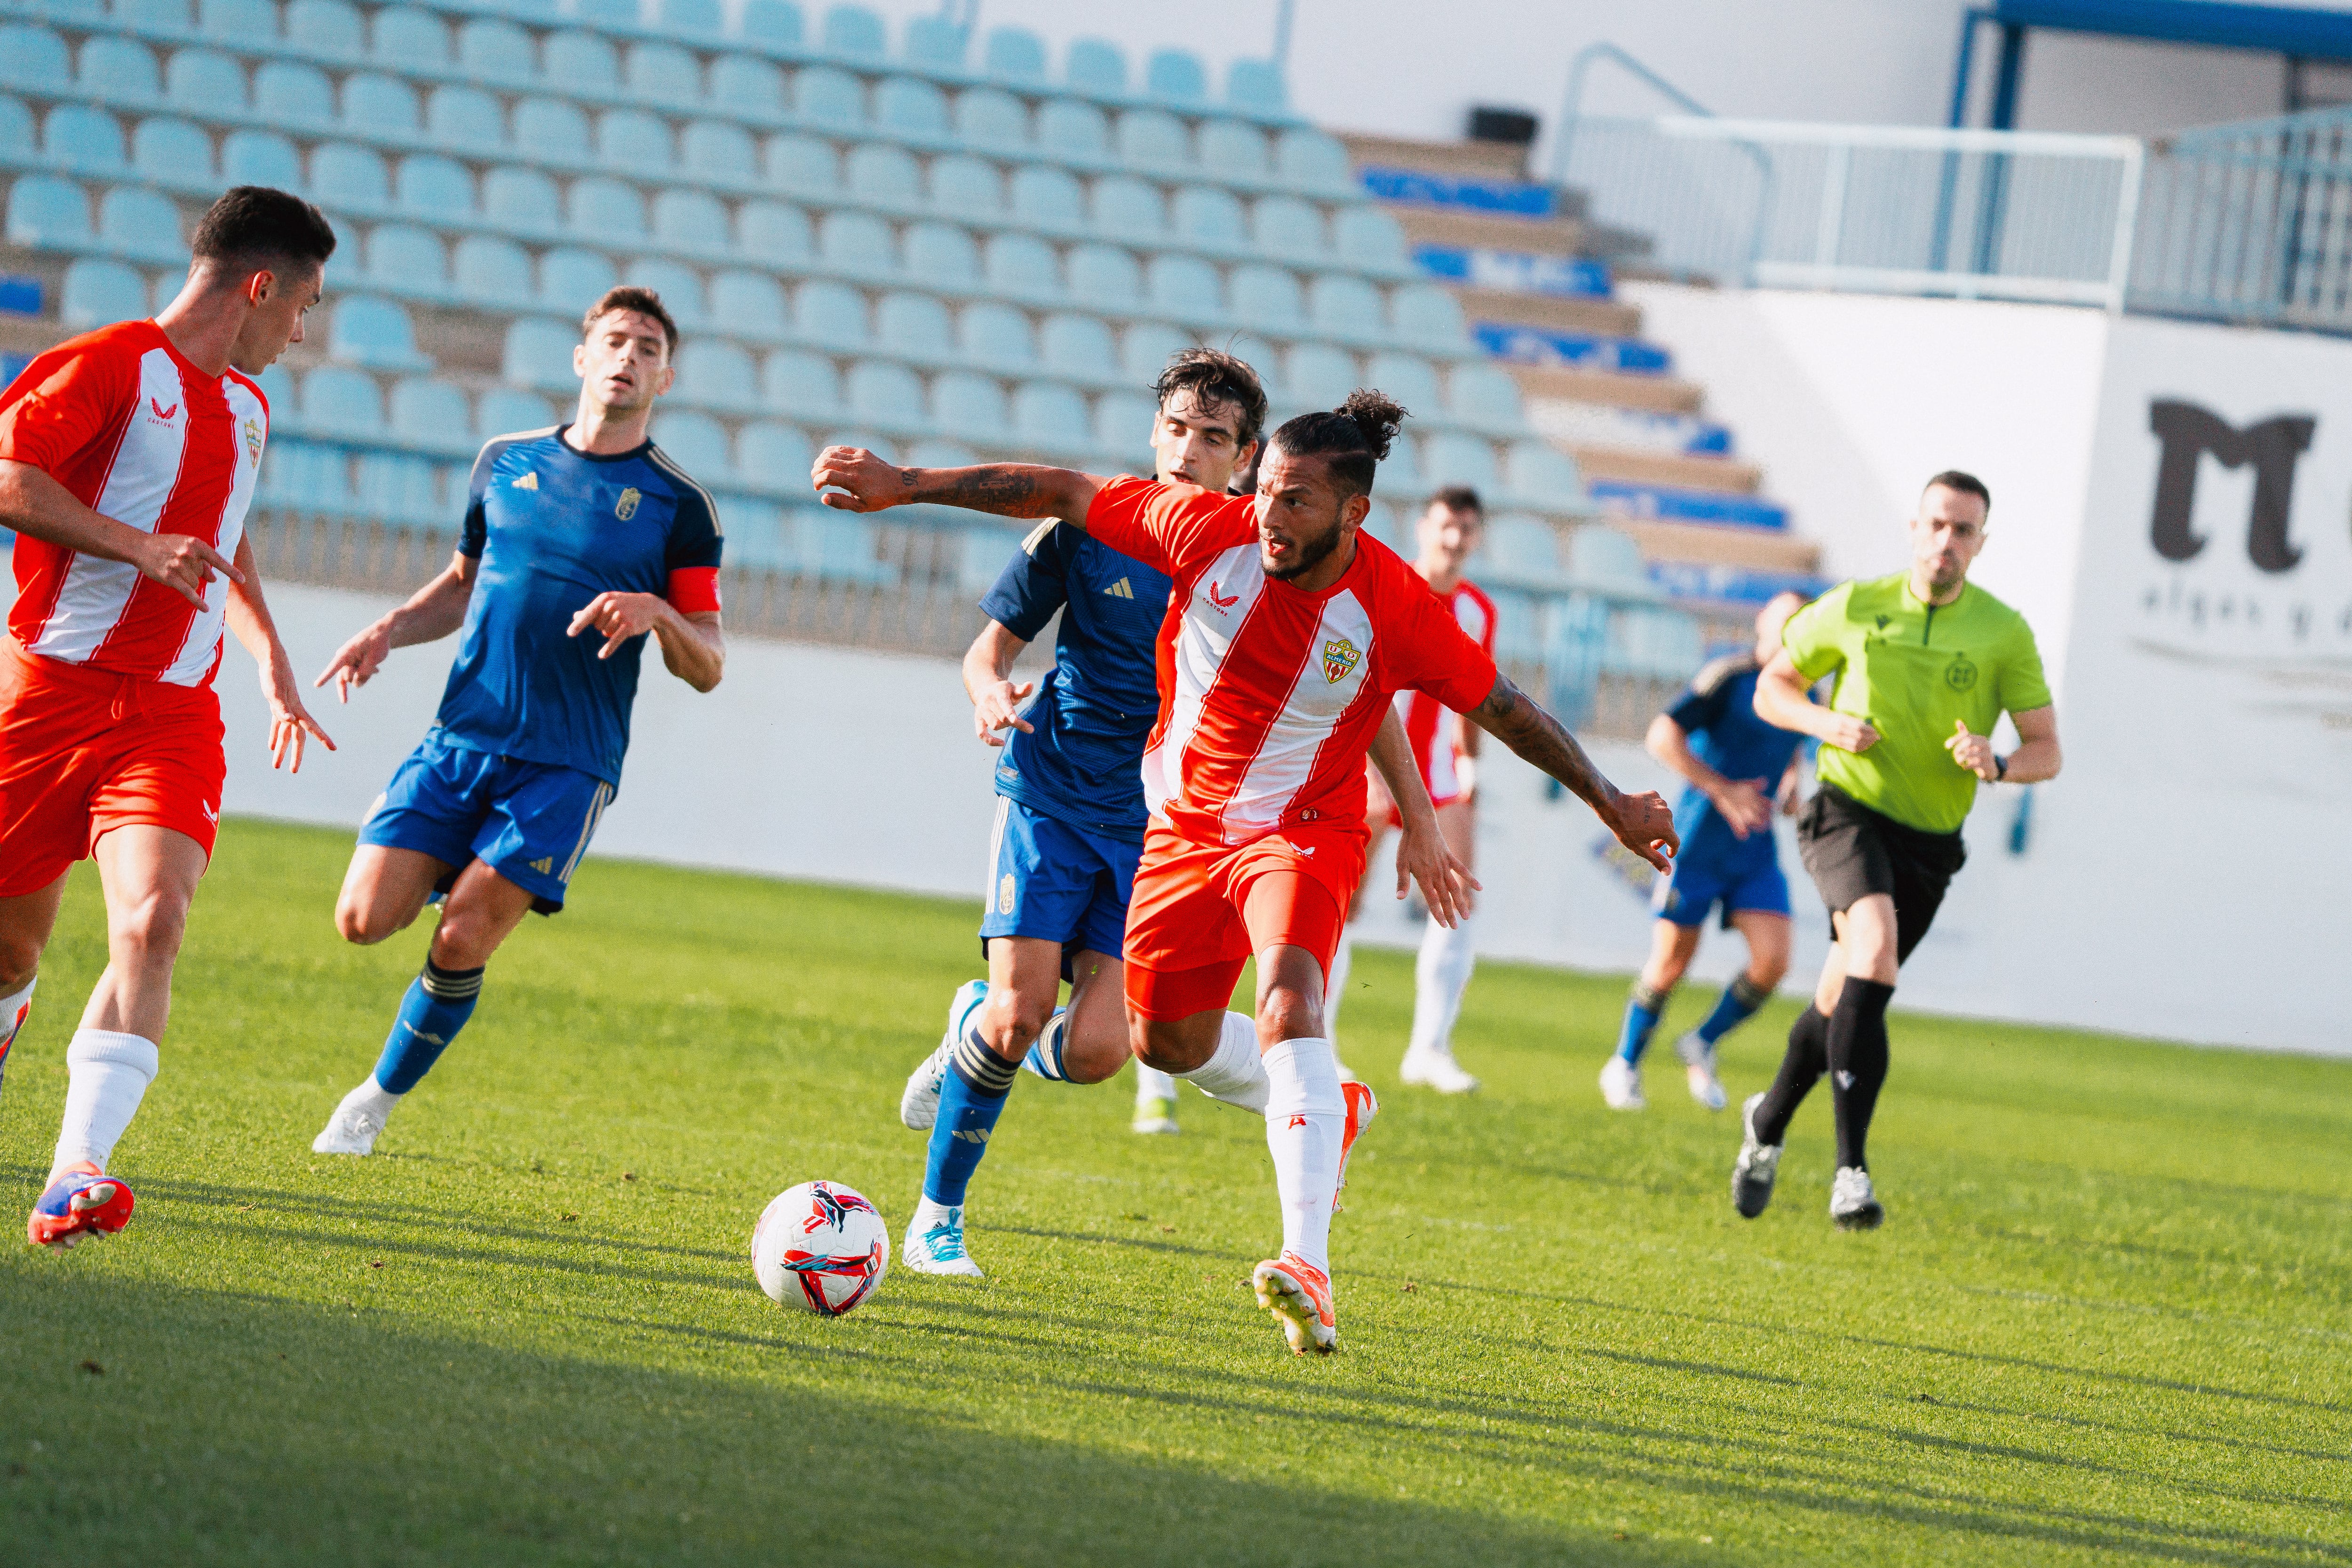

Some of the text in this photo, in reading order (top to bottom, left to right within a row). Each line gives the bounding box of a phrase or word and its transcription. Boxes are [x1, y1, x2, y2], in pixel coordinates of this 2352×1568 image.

[2149, 396, 2352, 575] M
[1203, 597, 1228, 617] CASTORE
[1327, 654, 1352, 667] ALMERIA
